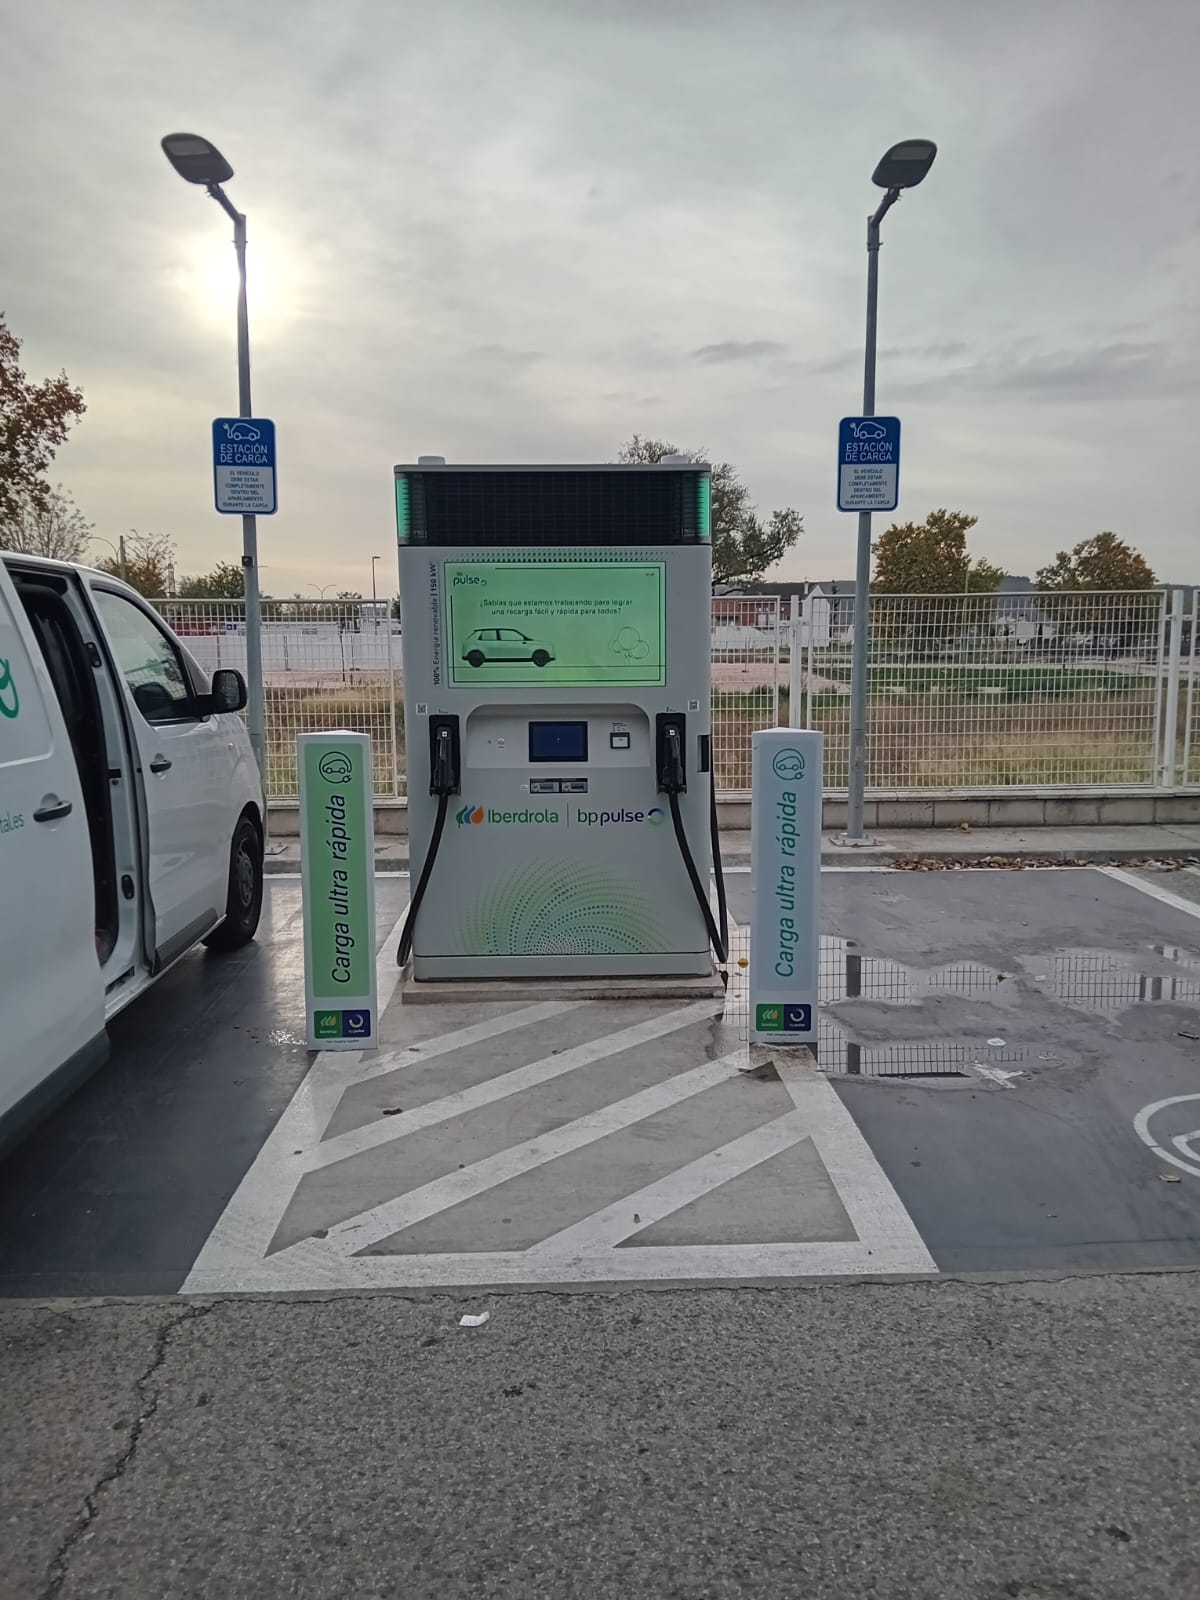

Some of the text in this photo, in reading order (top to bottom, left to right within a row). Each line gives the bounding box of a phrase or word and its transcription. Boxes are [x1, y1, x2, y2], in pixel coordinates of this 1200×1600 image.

[220, 443, 268, 454] ESTACIÓN
[846, 441, 892, 452] ESTACIÓN
[220, 453, 268, 463] DE CARGA
[845, 452, 892, 461] DE CARGA
[429, 563, 437, 577] kW
[453, 575, 480, 587] pulse
[612, 599, 633, 607] lograr
[431, 598, 439, 635] renovable
[556, 608, 579, 616] rápida
[487, 808, 559, 823] Iberdrola
[325, 794, 355, 983] Carga ultra rápida
[775, 791, 801, 977] Carga ultra rápida
